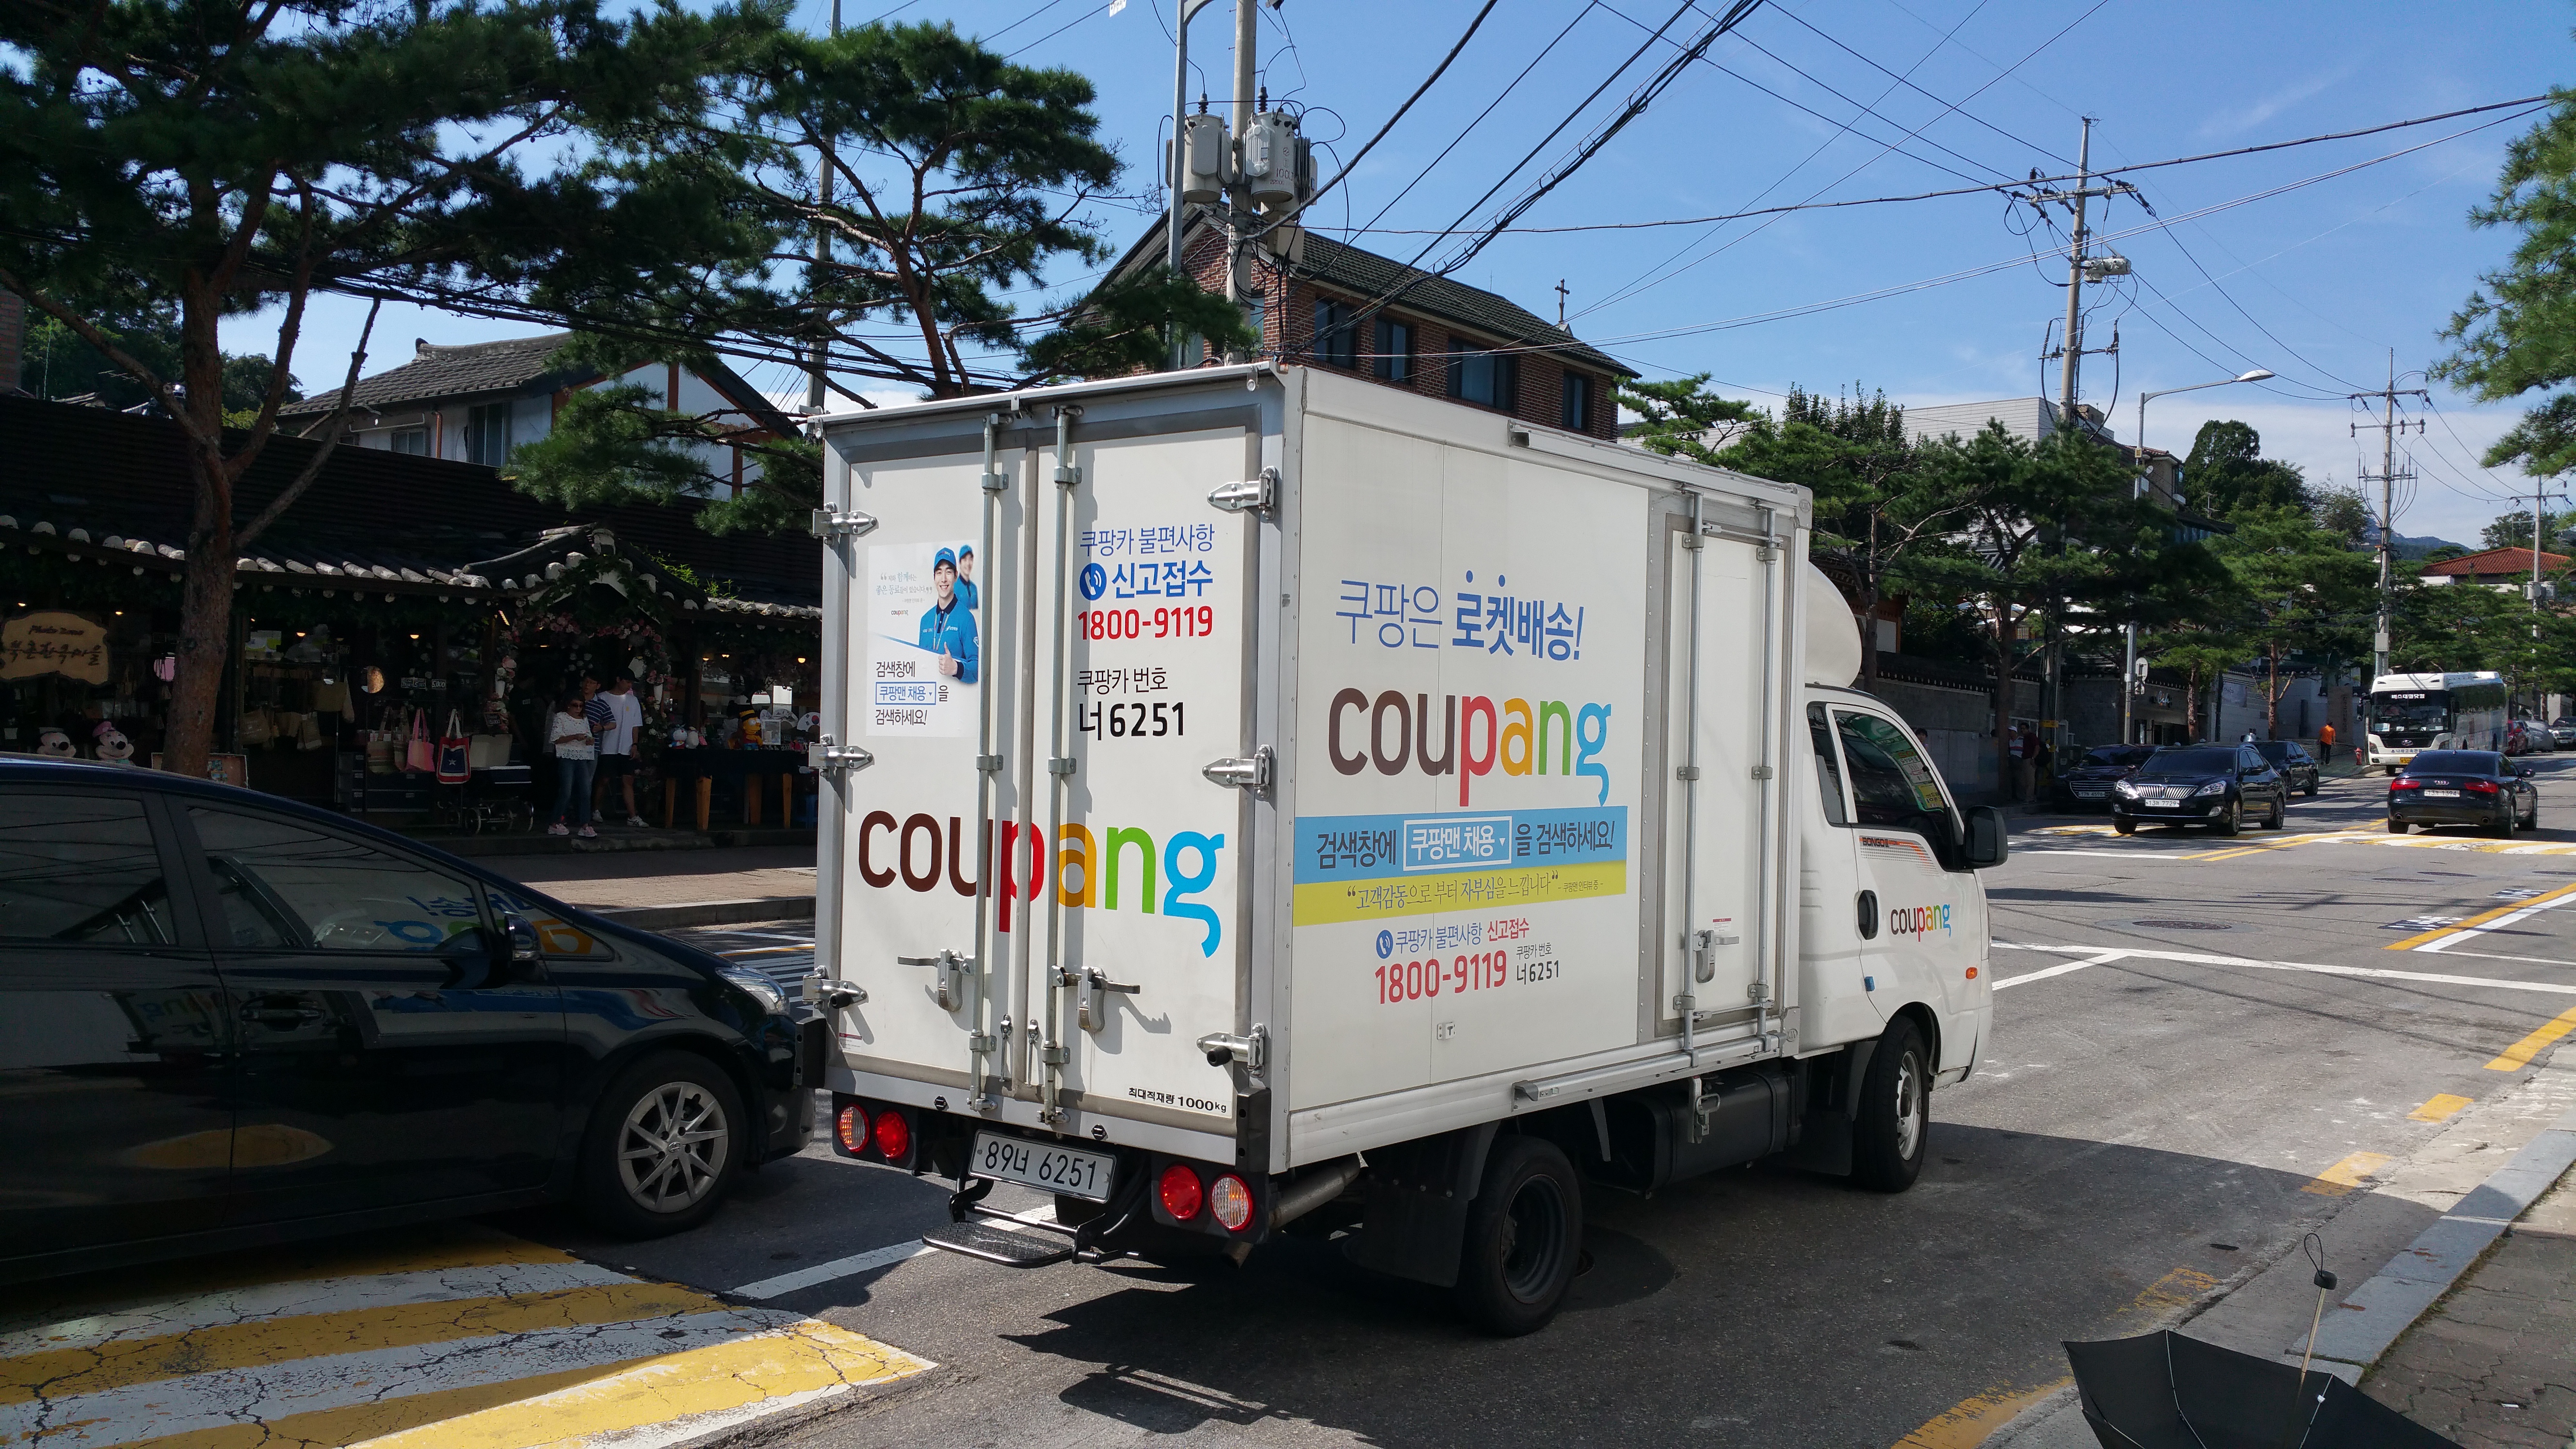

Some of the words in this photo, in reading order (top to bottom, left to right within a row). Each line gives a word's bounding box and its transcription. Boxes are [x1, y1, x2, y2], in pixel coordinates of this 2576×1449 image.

[1080, 529, 1134, 556] 쿠팡카
[1139, 523, 1215, 554] 불편사항
[876, 585, 888, 596] 좋은
[1111, 560, 1213, 599] 신고접수
[1078, 606, 1213, 640] 1800-9119
[1336, 580, 1443, 649] 쿠팡은
[1452, 570, 1584, 661] 로켓배송!
[876, 661, 916, 677] 검색창에
[1078, 668, 1129, 695] 쿠팡카
[1134, 667, 1168, 693] 번호
[880, 686, 905, 701] 쿠팡맨
[908, 686, 926, 701] 채용
[938, 685, 949, 702] 을
[875, 709, 927, 725] 검색하세요!
[1328, 688, 1611, 807] coupang
[1317, 829, 1397, 870] 검색창에
[1411, 826, 1460, 860] 쿠팡맨
[1463, 825, 1495, 857] 채용
[1515, 823, 1532, 857] 을
[1536, 820, 1615, 855] 검색하세요!
[859, 810, 1224, 958] coupang
[1434, 880, 1457, 905] 부터
[1461, 876, 1506, 902] 자부심을
[1578, 881, 1592, 891] 인터뷰
[1593, 880, 1598, 890] 중
[1395, 928, 1433, 954] 쿠팡카
[1435, 922, 1482, 950] 불편사항
[1487, 918, 1530, 942] 신고접수
[1891, 904, 1950, 942] coupang
[1516, 945, 1537, 960] 쿠팡카
[1539, 942, 1552, 957] 번호
[1375, 950, 1507, 1004] 1800-9119
[1128, 1087, 1175, 1104] 최대적재량
[985, 1141, 1030, 1175] 89너
[1039, 1152, 1096, 1190] 6251
